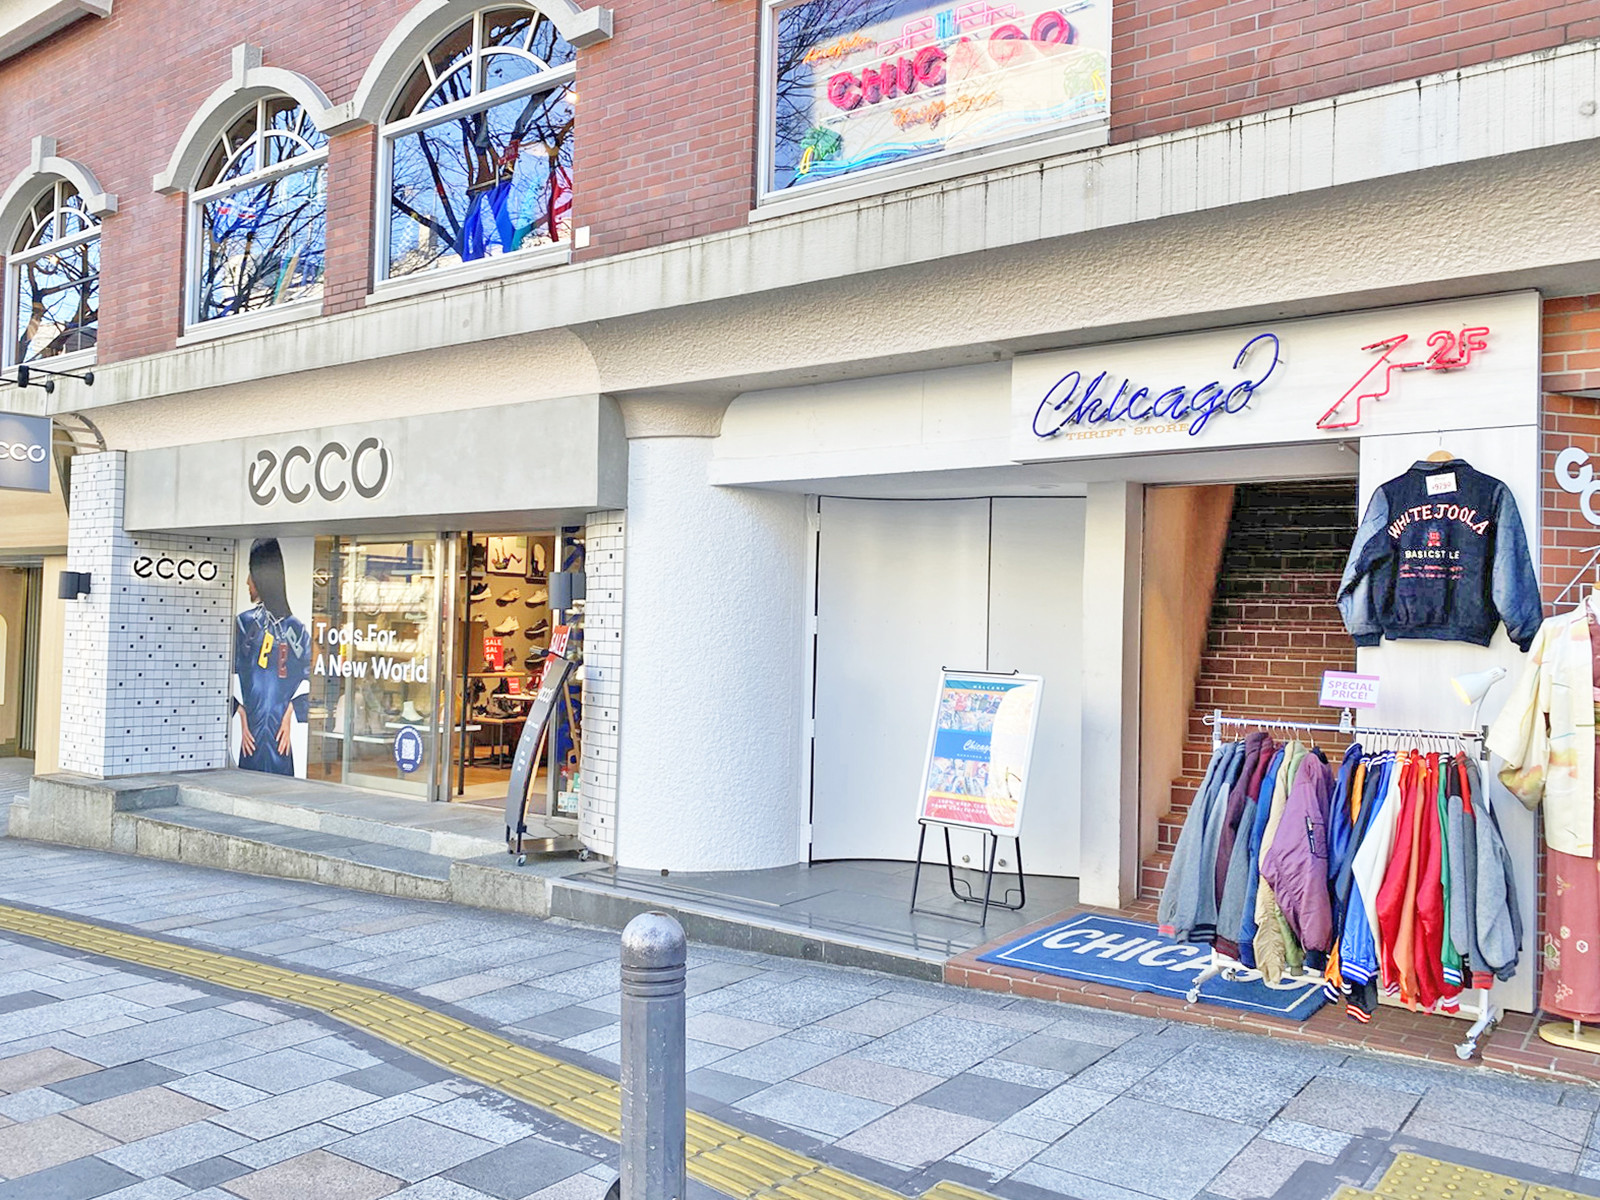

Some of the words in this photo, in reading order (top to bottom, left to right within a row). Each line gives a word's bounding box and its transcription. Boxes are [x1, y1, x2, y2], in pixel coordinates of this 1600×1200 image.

[1426, 326, 1490, 370] 2F
[1032, 333, 1280, 438] Chicago
[1066, 428, 1127, 442] THRIFT
[1133, 423, 1192, 435] STORE
[249, 437, 393, 506] ecco
[1404, 549, 1460, 560] BASICSTLE
[134, 556, 217, 581] ecco
[316, 622, 363, 646] Tools
[367, 623, 397, 646] For
[314, 654, 326, 676] A
[329, 654, 368, 679] New
[372, 656, 429, 683] World
[1327, 680, 1374, 692] SPECIAL
[1331, 689, 1368, 700] PRICE!
[963, 739, 991, 754] Chicag
